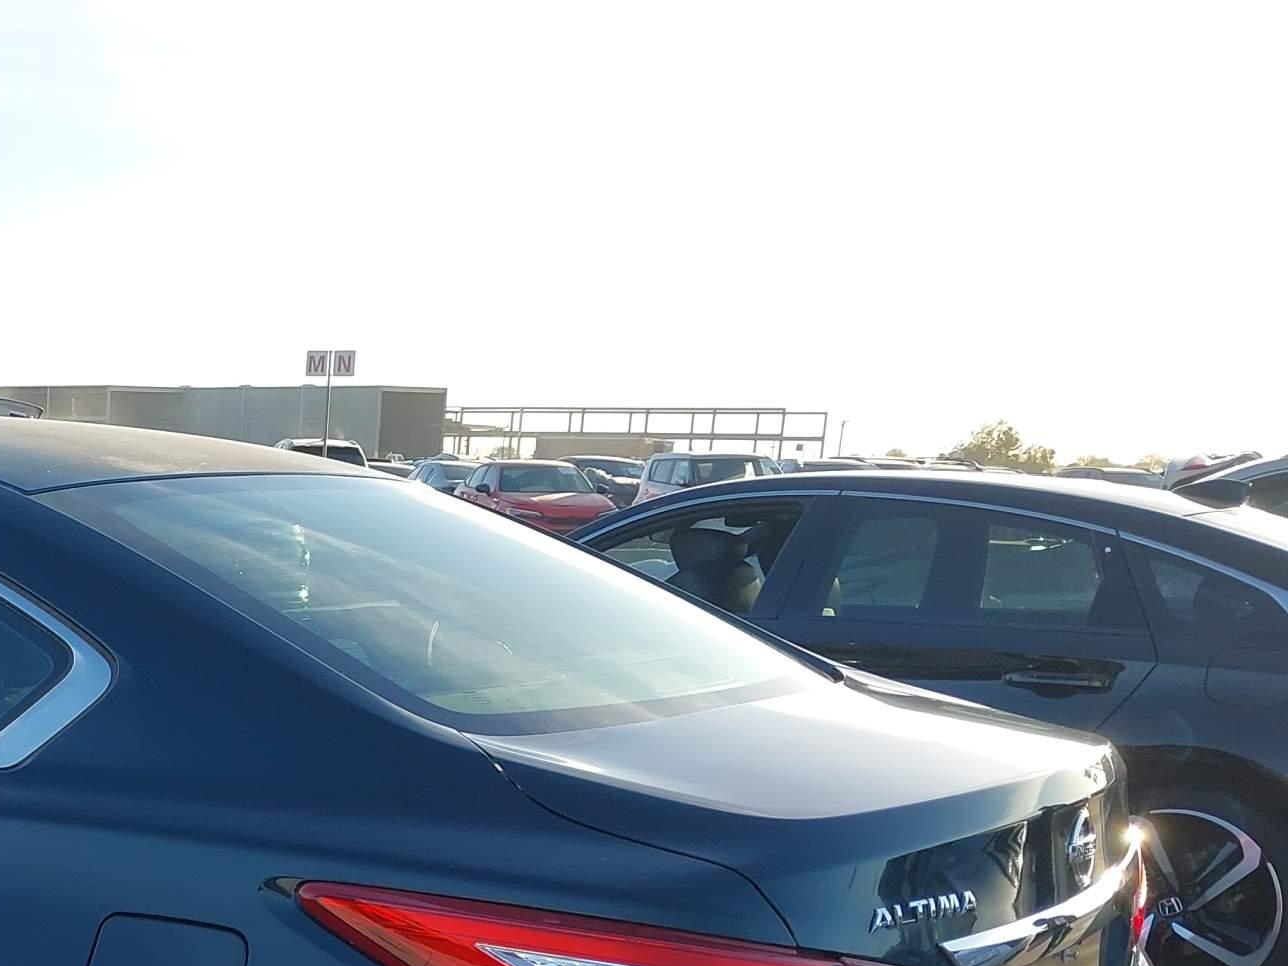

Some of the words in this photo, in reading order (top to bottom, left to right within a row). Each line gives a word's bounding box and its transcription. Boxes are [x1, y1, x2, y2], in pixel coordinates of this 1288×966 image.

[308, 355, 325, 373] M
[337, 355, 352, 373] N
[869, 890, 977, 933] ALTIMA
